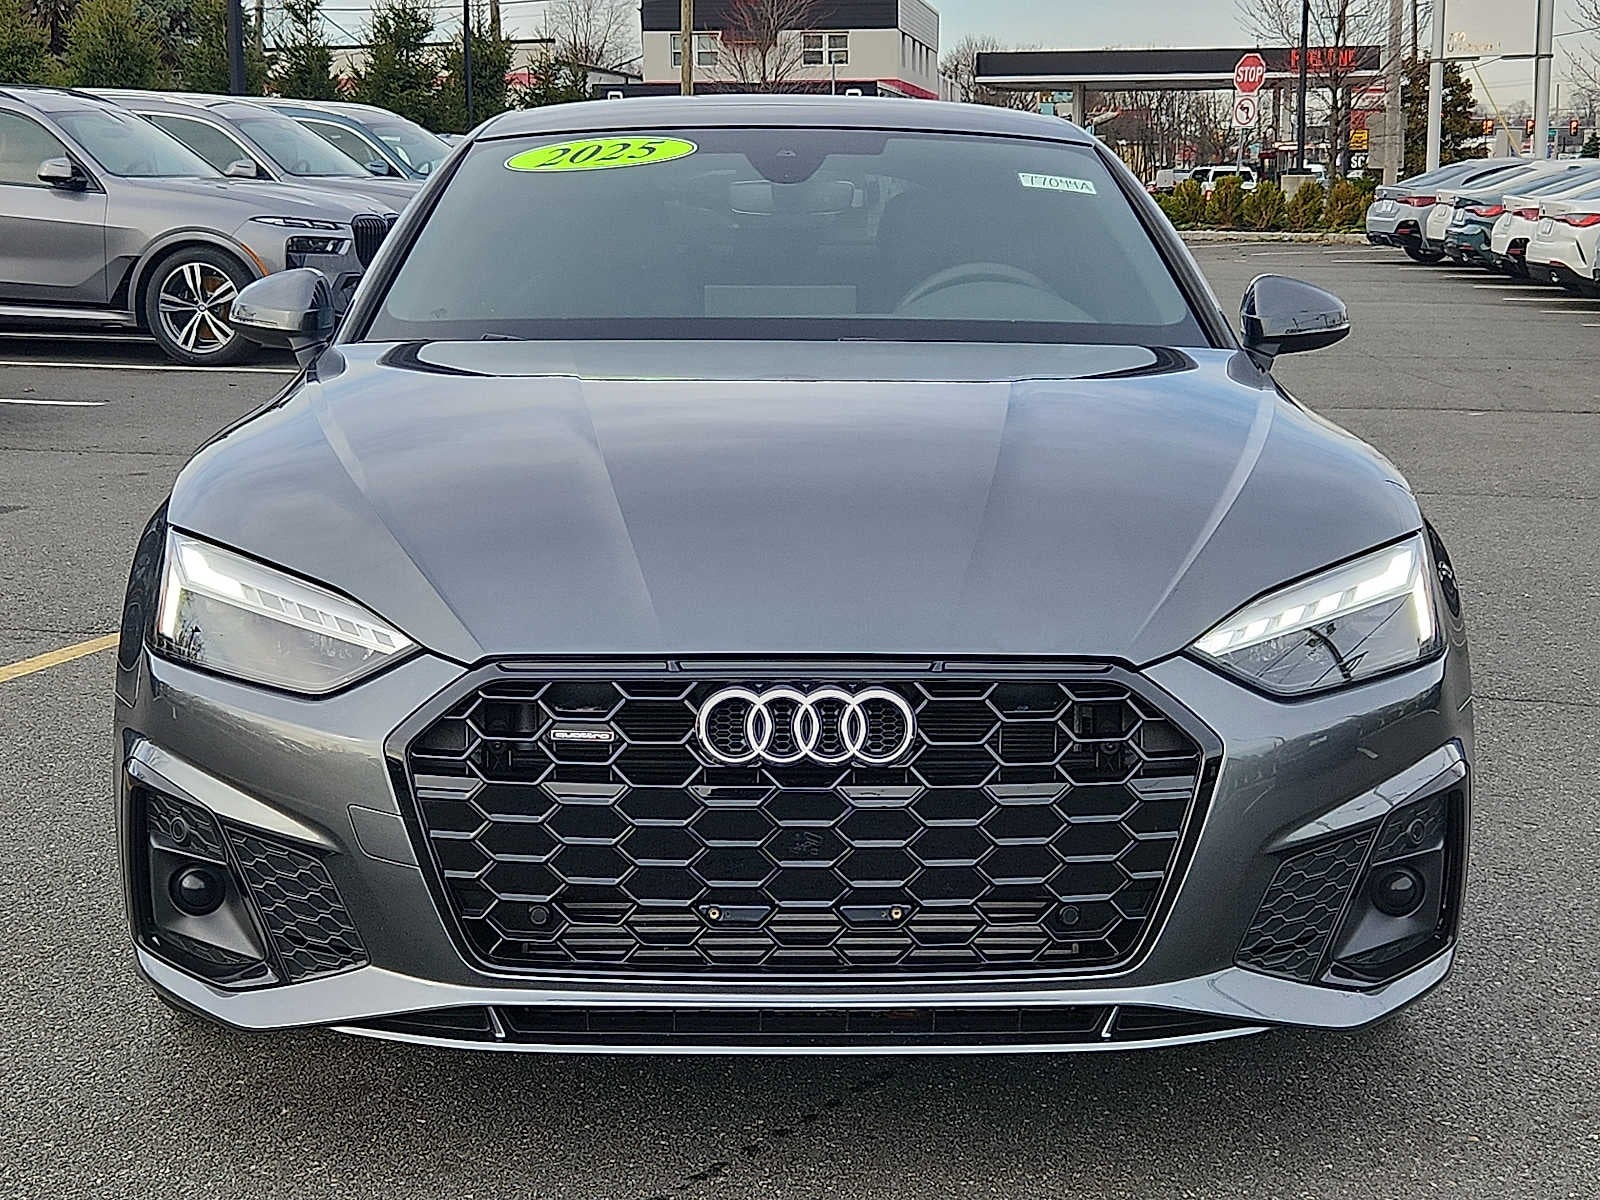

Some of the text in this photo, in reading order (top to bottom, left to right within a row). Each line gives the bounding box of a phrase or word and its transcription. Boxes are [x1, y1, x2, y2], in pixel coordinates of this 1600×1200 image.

[1236, 66, 1263, 82] STOP
[535, 140, 665, 168] 2025
[553, 731, 611, 740] quattro
